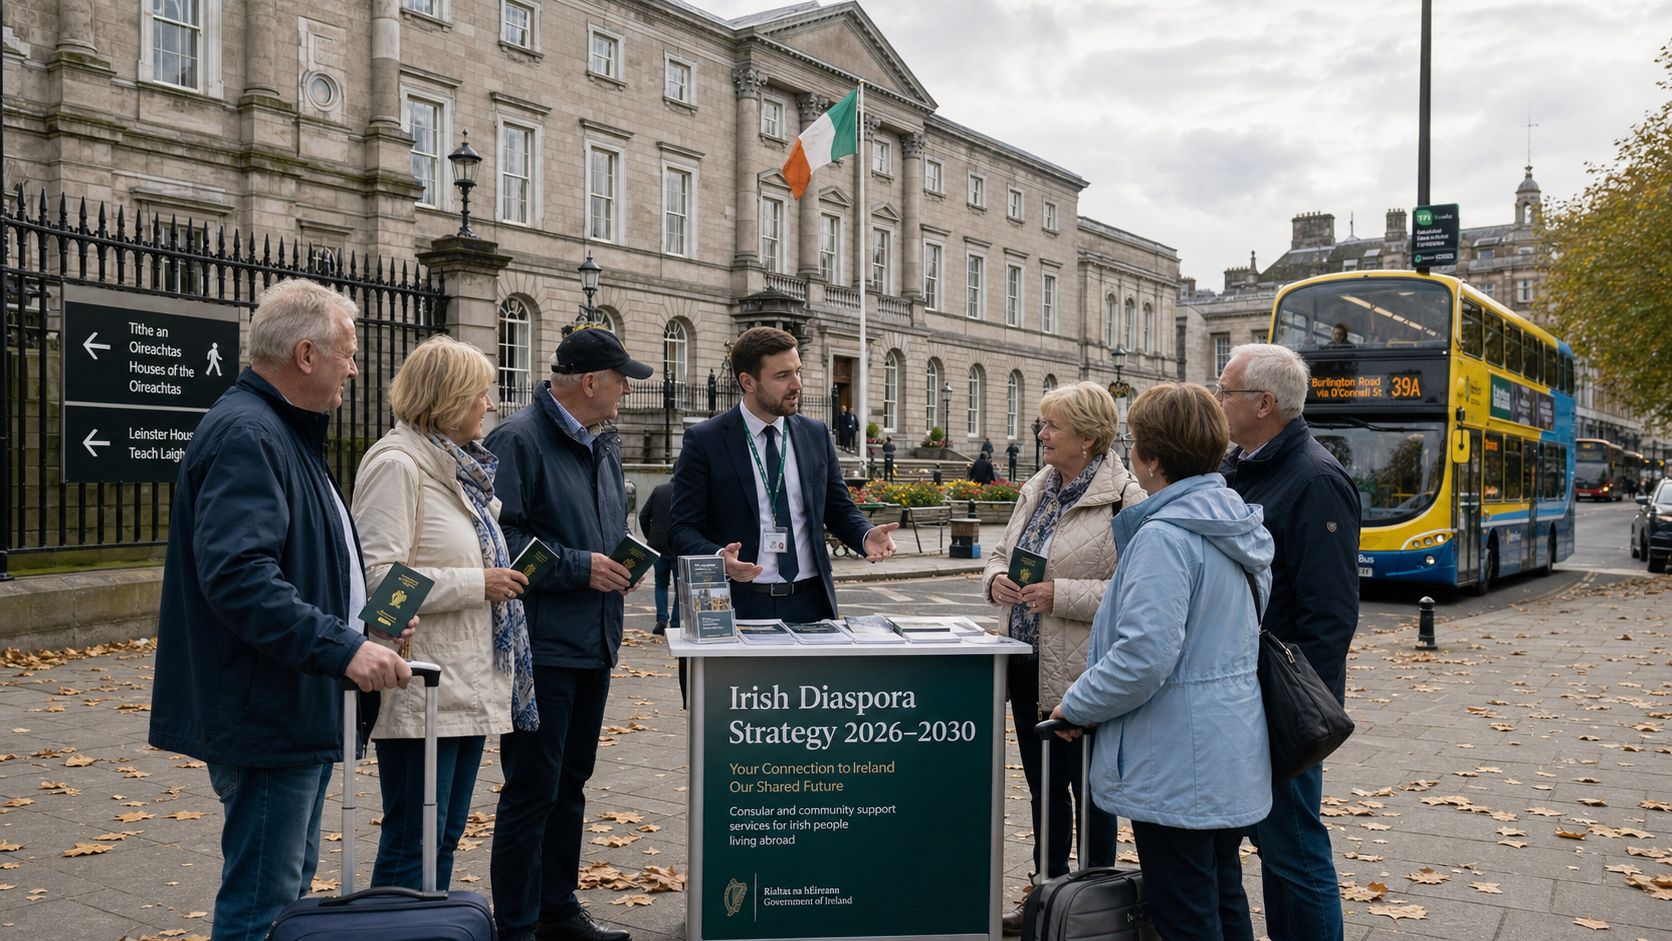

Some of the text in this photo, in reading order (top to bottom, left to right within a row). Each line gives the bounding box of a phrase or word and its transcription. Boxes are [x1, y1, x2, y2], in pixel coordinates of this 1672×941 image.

[128, 322, 168, 338] Tithe an
[129, 341, 182, 357] Oireachtas
[129, 360, 194, 378] Houses of the
[129, 380, 182, 395] Oireachtas
[1312, 376, 1380, 388] Burlington Road
[1391, 376, 1421, 397] 39A
[1316, 388, 1329, 397] via
[1372, 388, 1382, 397] St
[129, 427, 194, 440] Leinster Hous
[129, 447, 186, 462] Teach Laigh
[1358, 554, 1374, 563] Bus
[730, 684, 916, 716] Irish Diaspora
[729, 720, 976, 750] Strategy 2026–2030
[730, 761, 895, 775] Your Connection to Ireland
[730, 780, 844, 793] Our Shared Future
[730, 805, 896, 817] Consular and community support
[730, 820, 770, 831] services
[773, 820, 787, 830] for
[813, 819, 849, 831] people
[730, 835, 795, 848] living abroad
[764, 886, 791, 895] Rialtas
[763, 896, 853, 906] Government of Ireland
